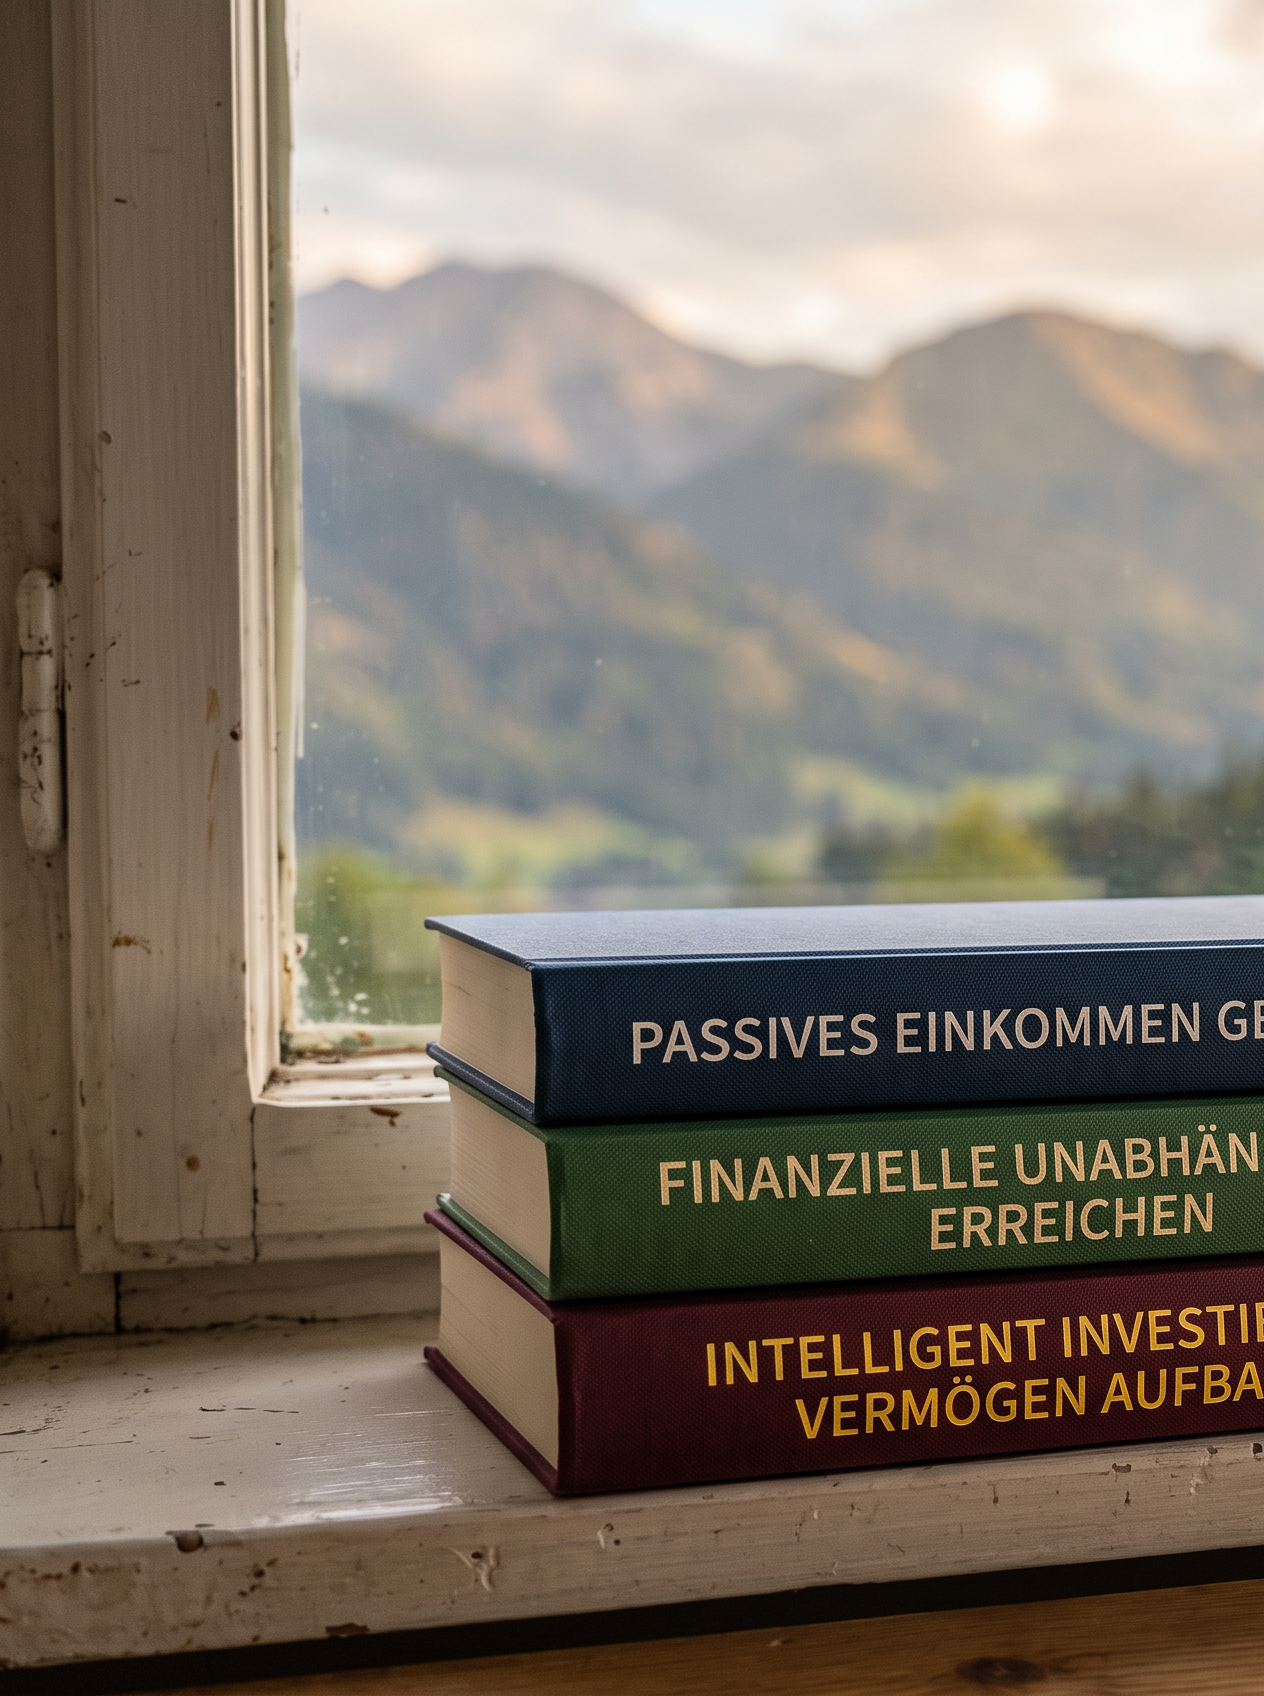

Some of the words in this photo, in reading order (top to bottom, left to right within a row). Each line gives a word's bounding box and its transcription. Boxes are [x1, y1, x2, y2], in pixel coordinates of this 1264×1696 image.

[631, 1012, 878, 1064] PASSIVES
[896, 1002, 1200, 1053] EINKOMMEN
[658, 1145, 999, 1206] FINANZIELLE
[931, 1192, 1214, 1250] ERREICHEN
[705, 1317, 1047, 1387] INTELLIGENT
[794, 1374, 1087, 1440] VERMÖGEN
